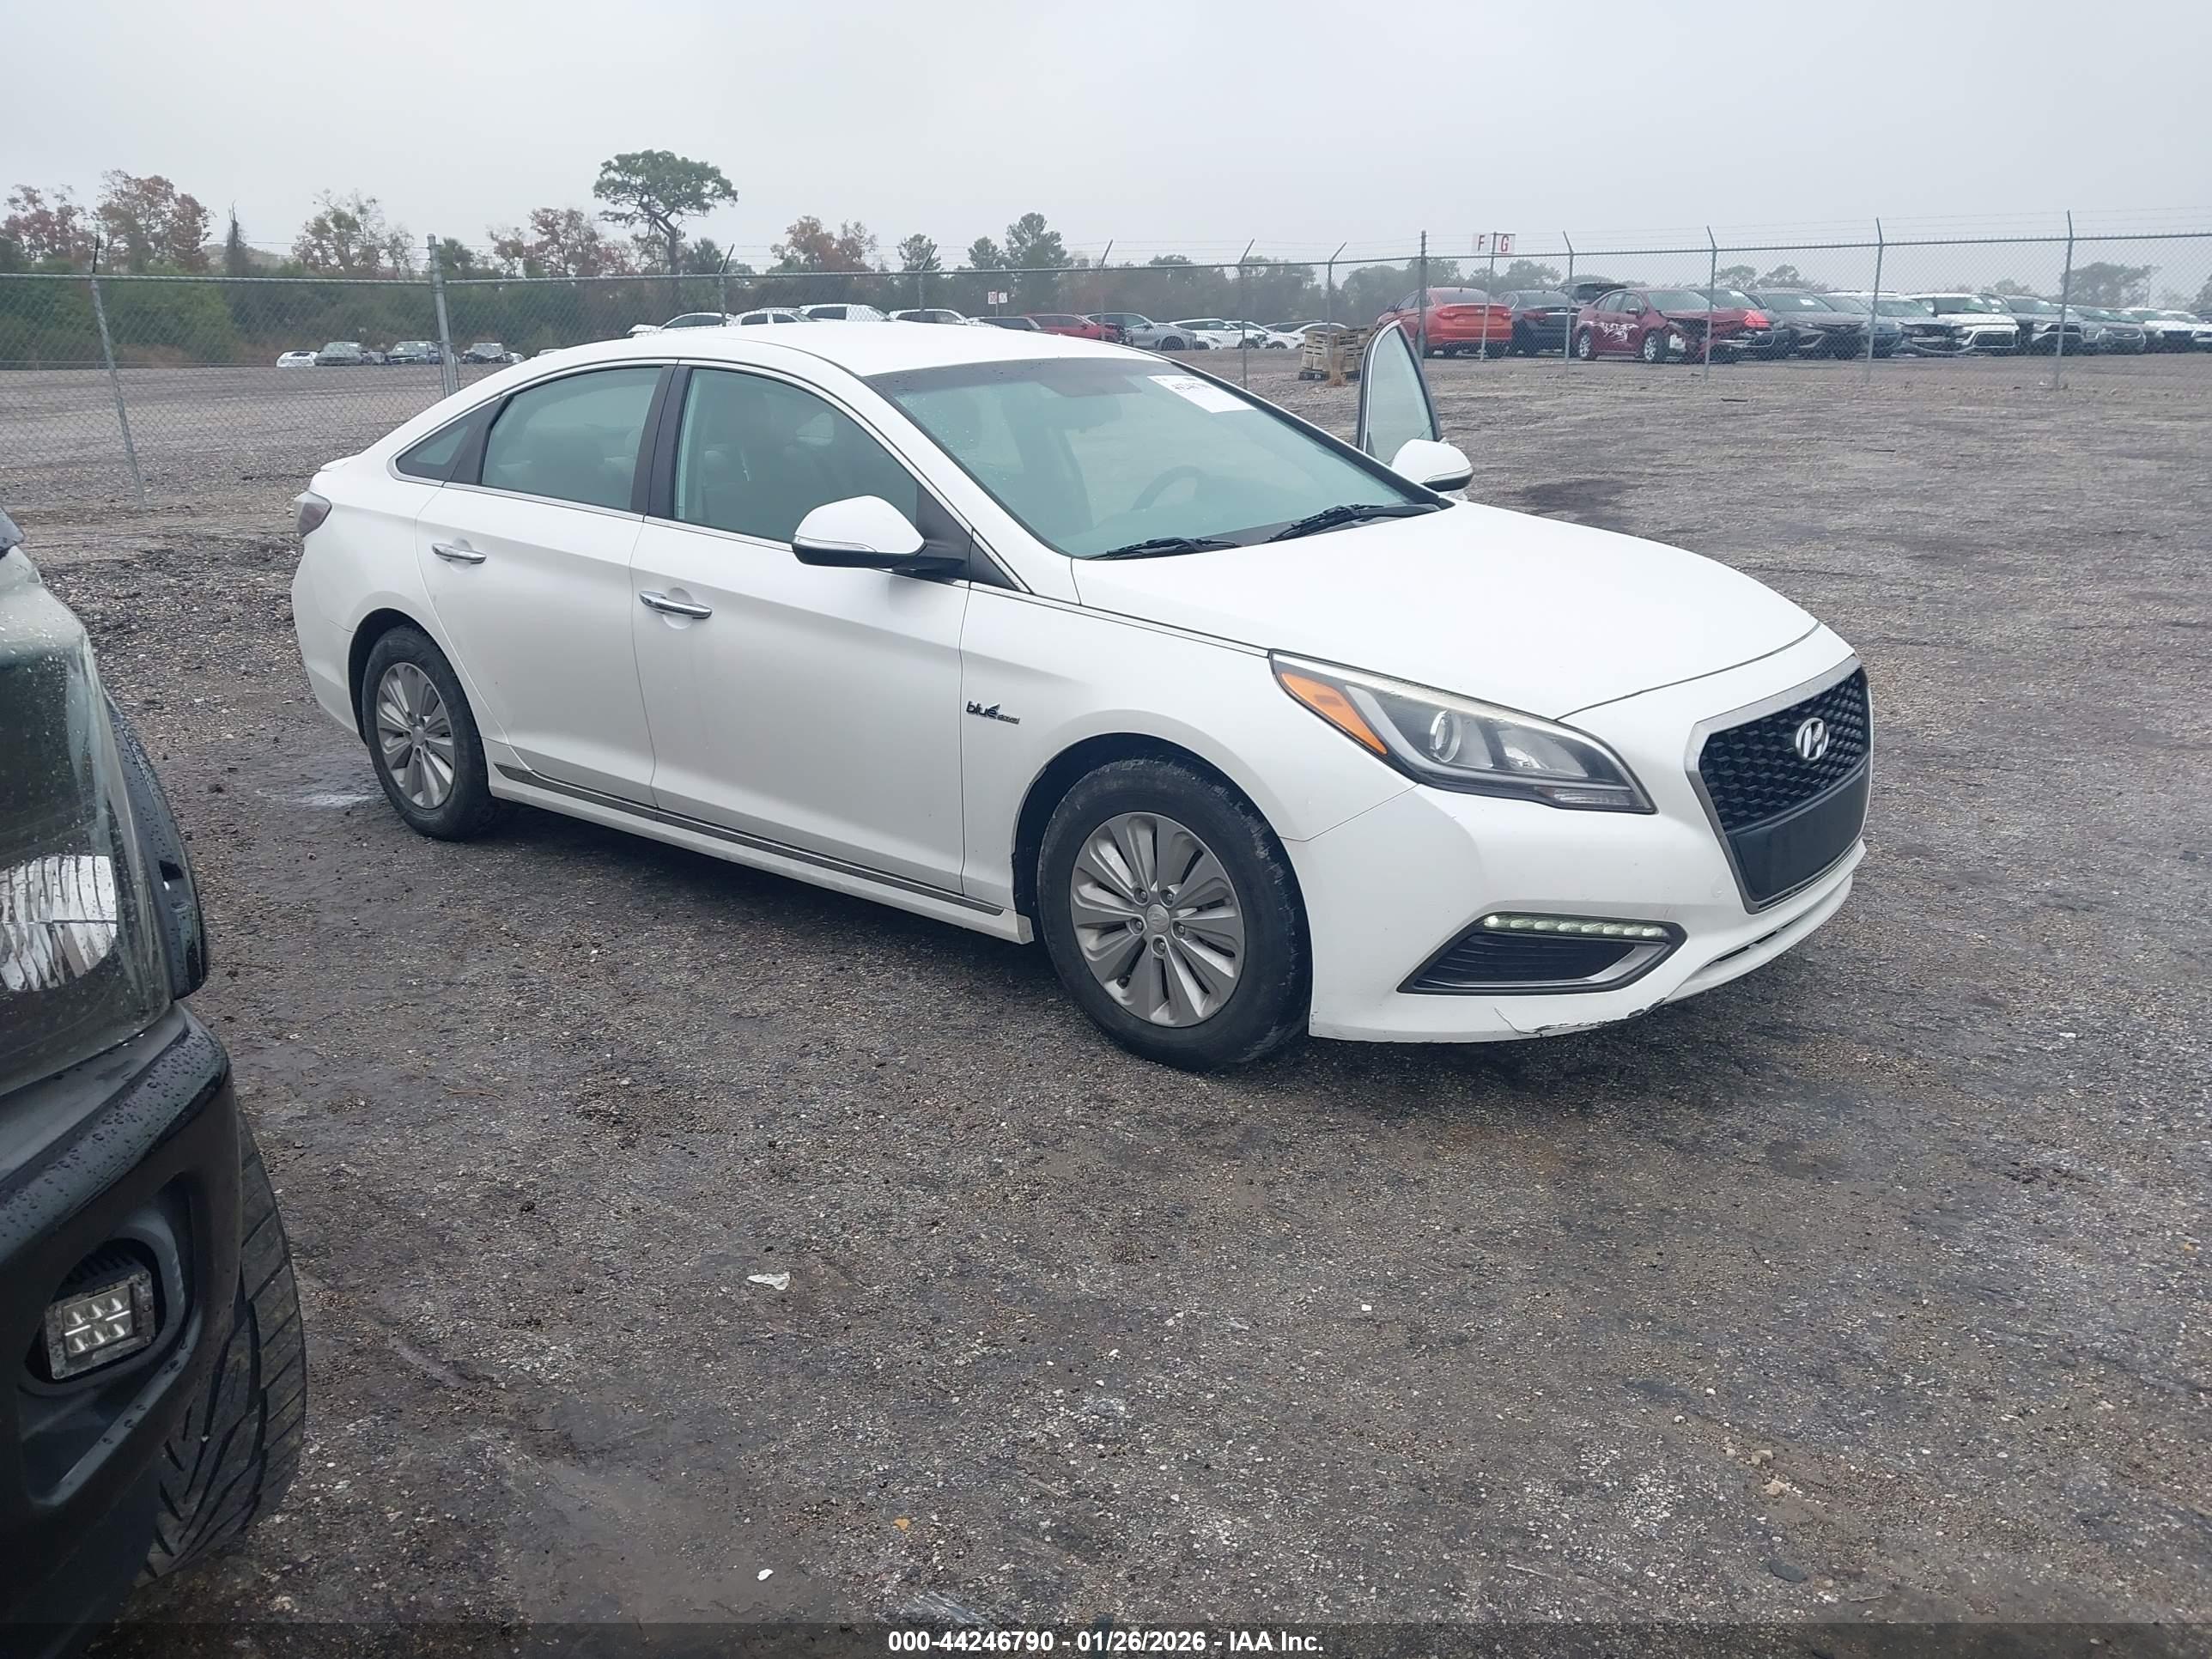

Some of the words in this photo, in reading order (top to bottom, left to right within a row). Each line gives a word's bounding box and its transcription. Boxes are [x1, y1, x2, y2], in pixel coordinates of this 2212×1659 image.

[1477, 234, 1486, 252] F
[1500, 235, 1510, 252] G
[966, 701, 999, 720] blue
